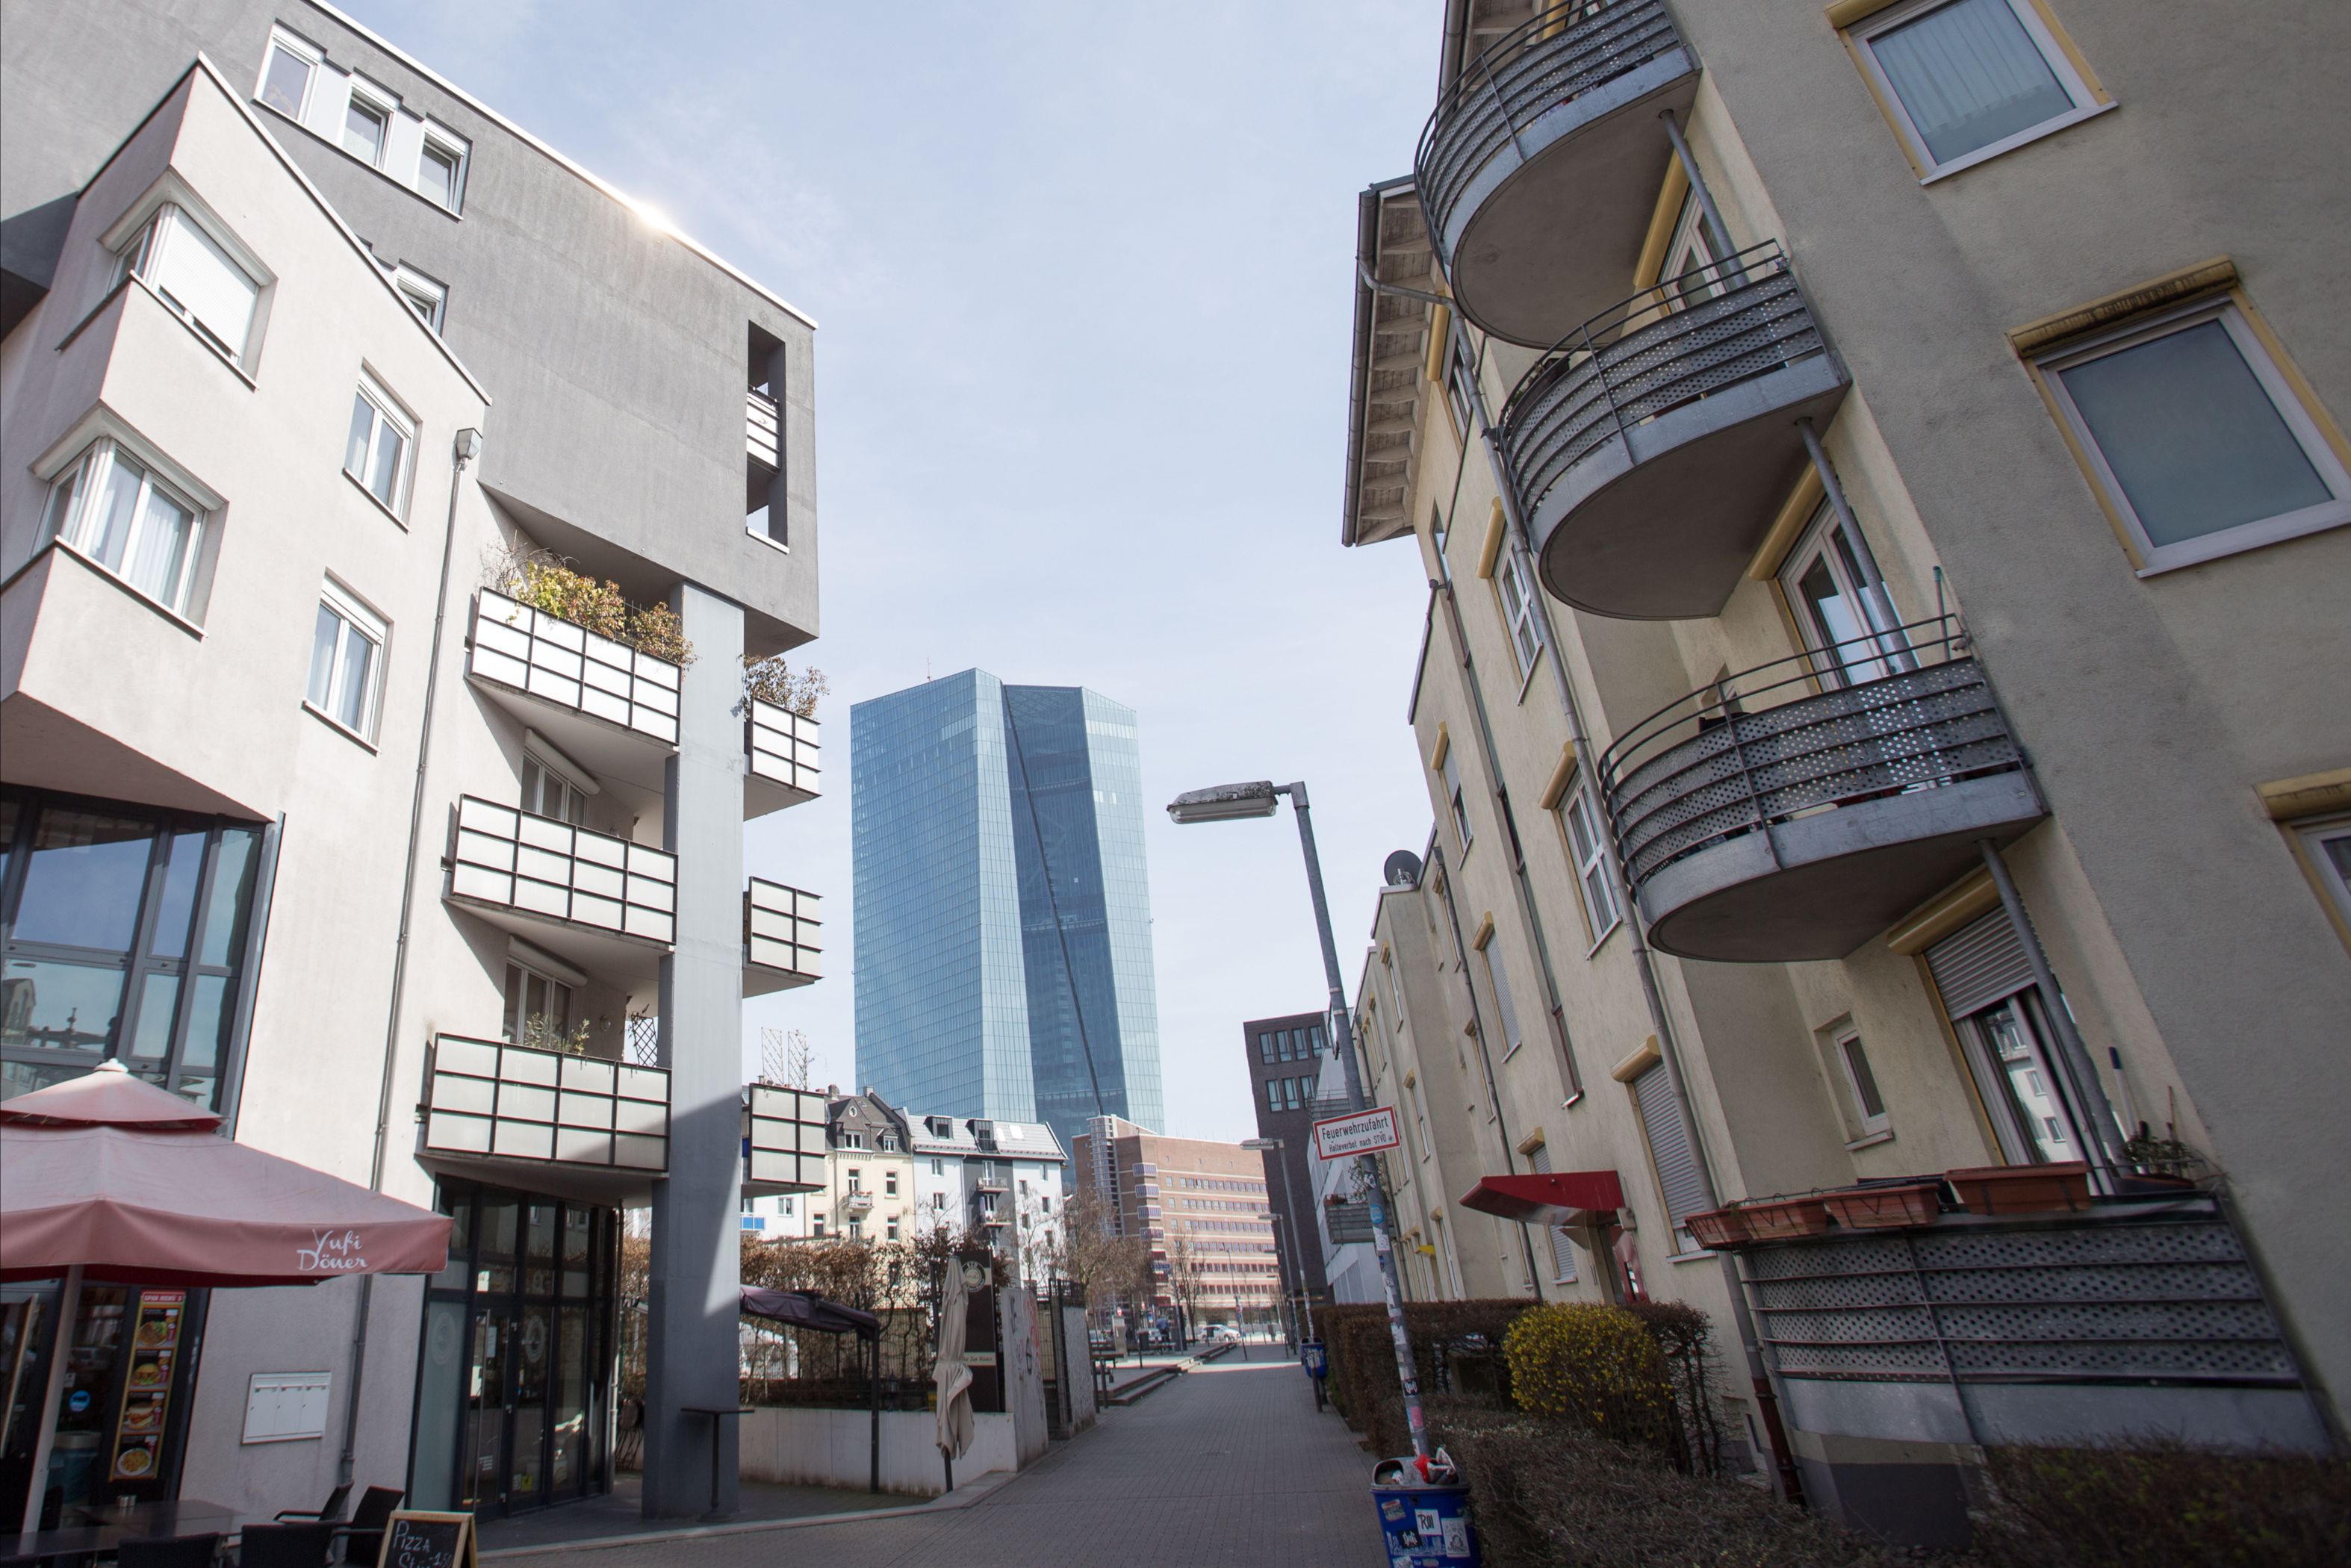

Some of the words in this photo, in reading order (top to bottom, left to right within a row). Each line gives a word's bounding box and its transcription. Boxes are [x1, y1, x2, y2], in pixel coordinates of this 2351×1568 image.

[1321, 1116, 1389, 1140] Feuerwehrzufahrt
[1328, 1139, 1358, 1153] Halteverbot
[1359, 1137, 1372, 1147] nach
[311, 1228, 363, 1256] Yufi
[296, 1249, 369, 1271] Döner
